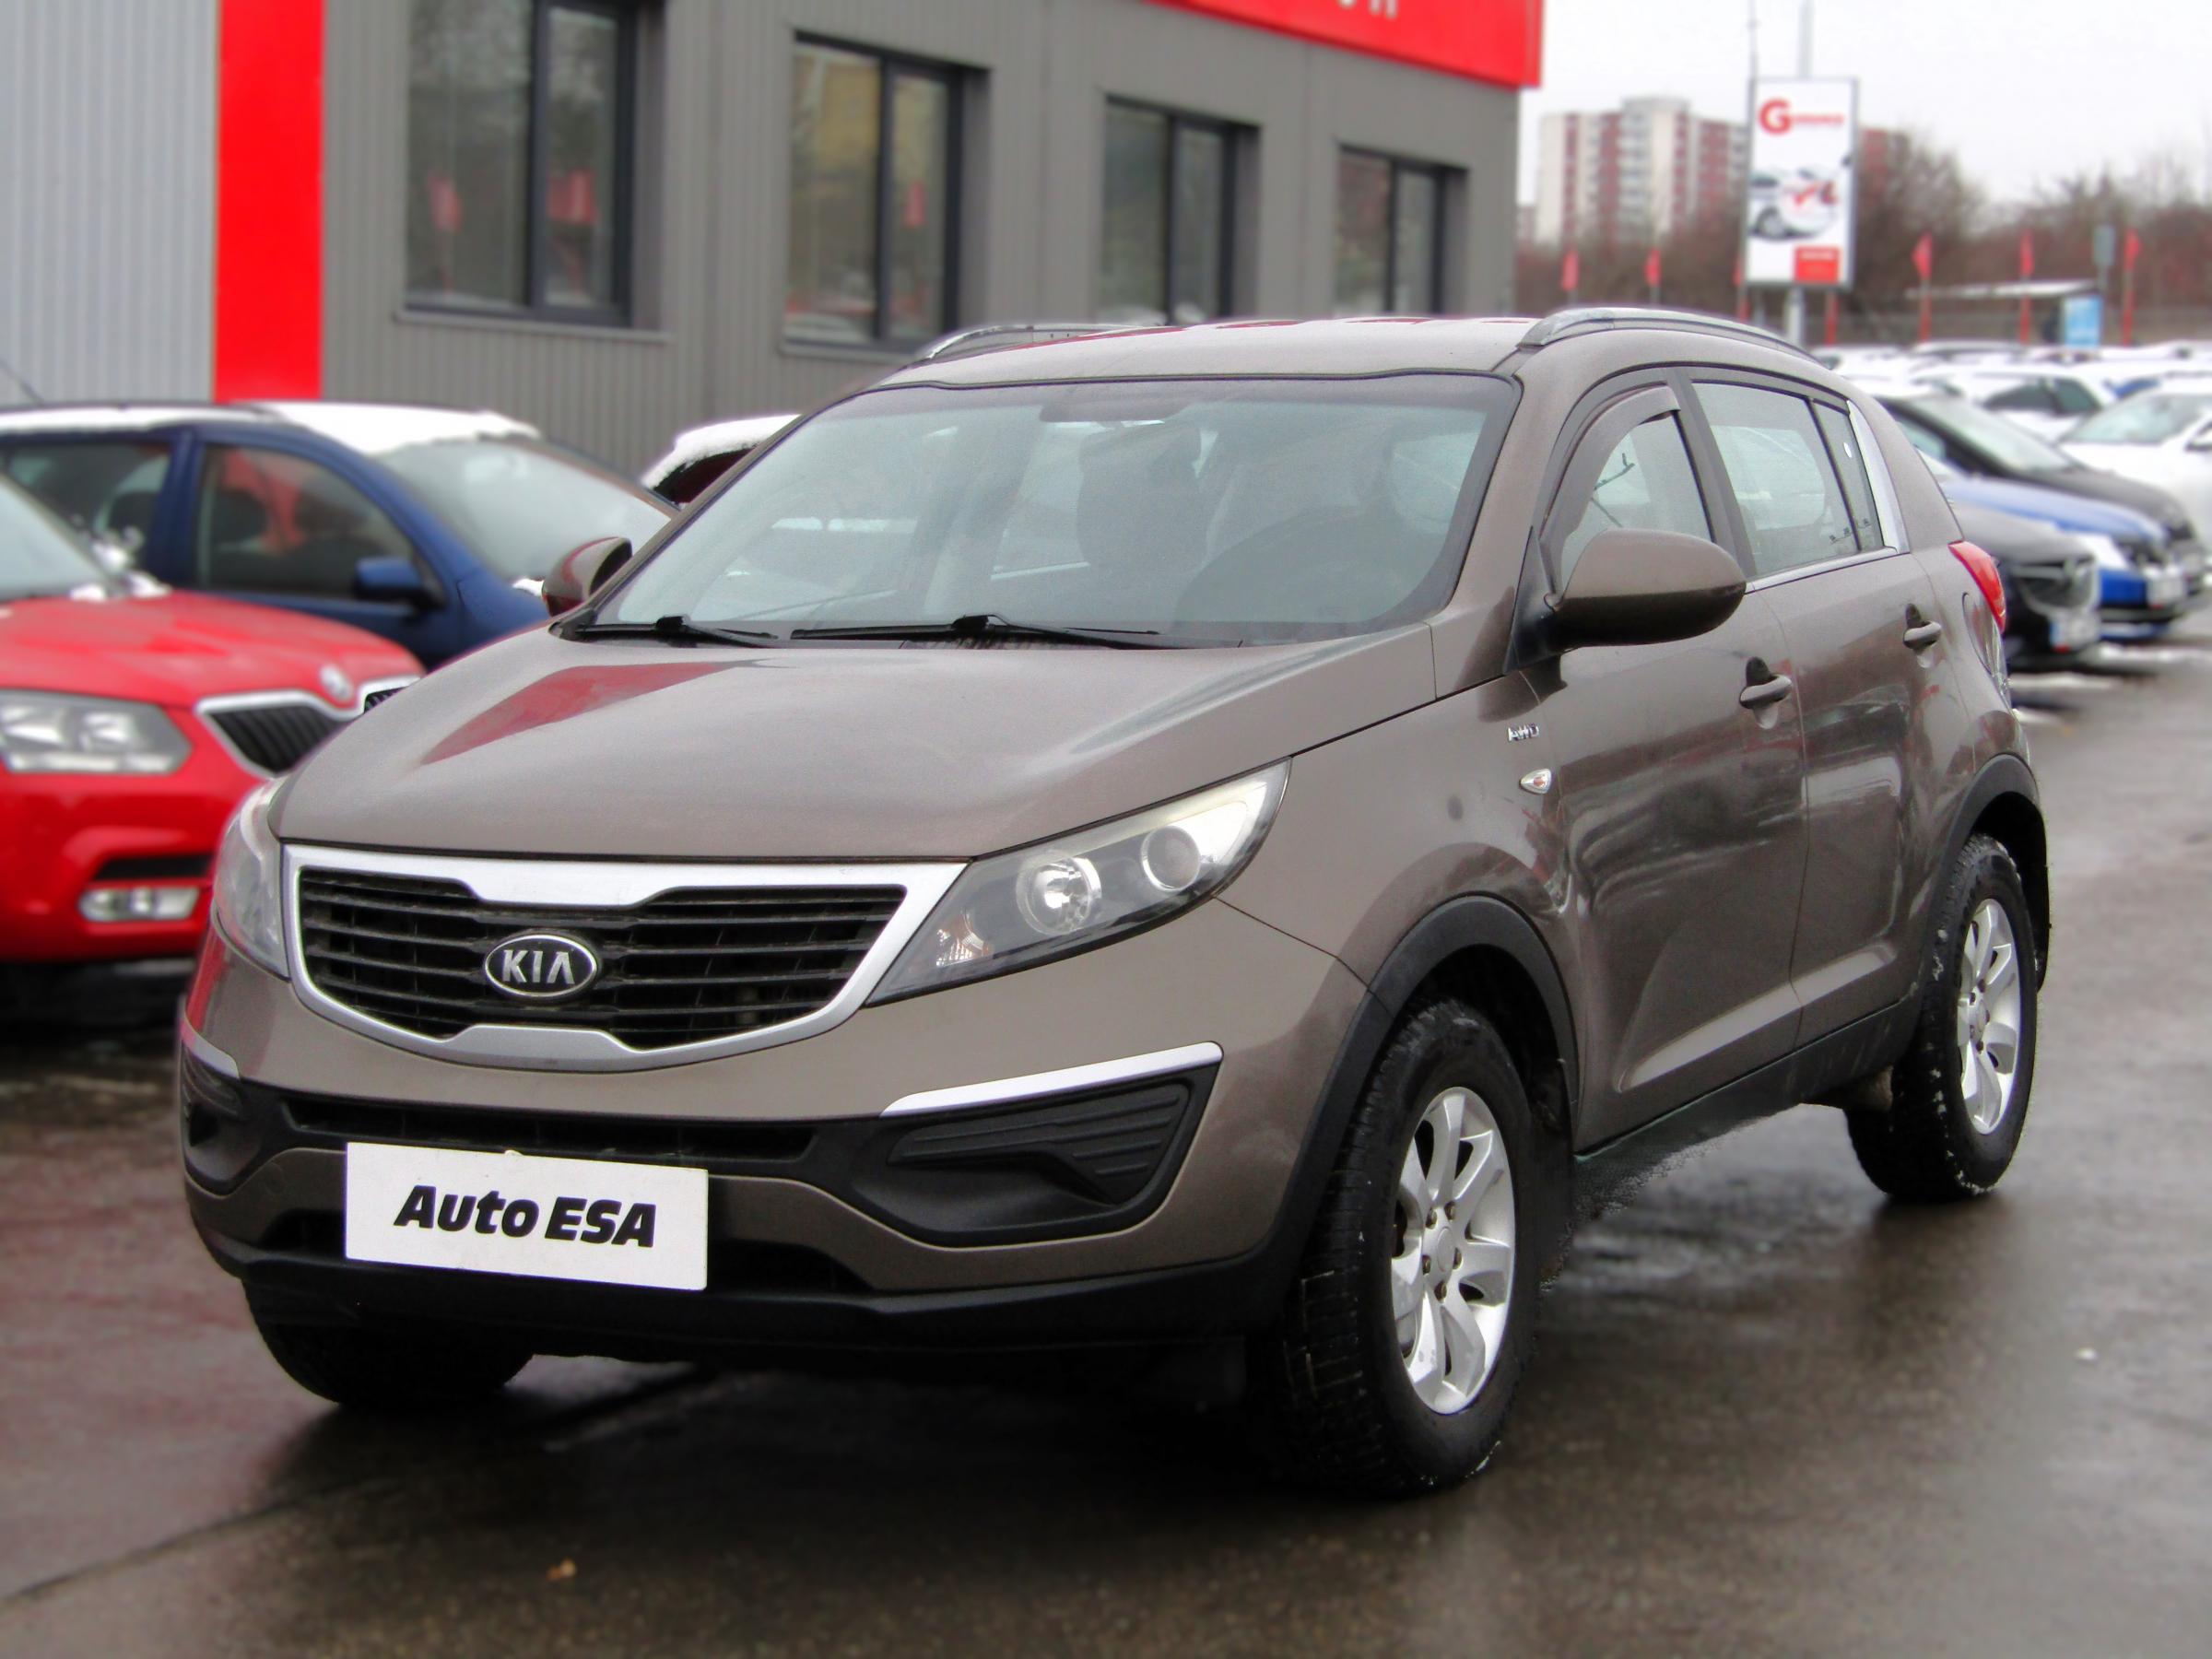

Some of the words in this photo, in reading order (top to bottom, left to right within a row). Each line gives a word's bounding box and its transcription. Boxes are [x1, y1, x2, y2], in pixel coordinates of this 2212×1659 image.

[1508, 724, 1539, 741] AWD
[501, 948, 575, 985] KIA
[393, 1184, 540, 1239] Auto
[545, 1195, 657, 1248] ESA
